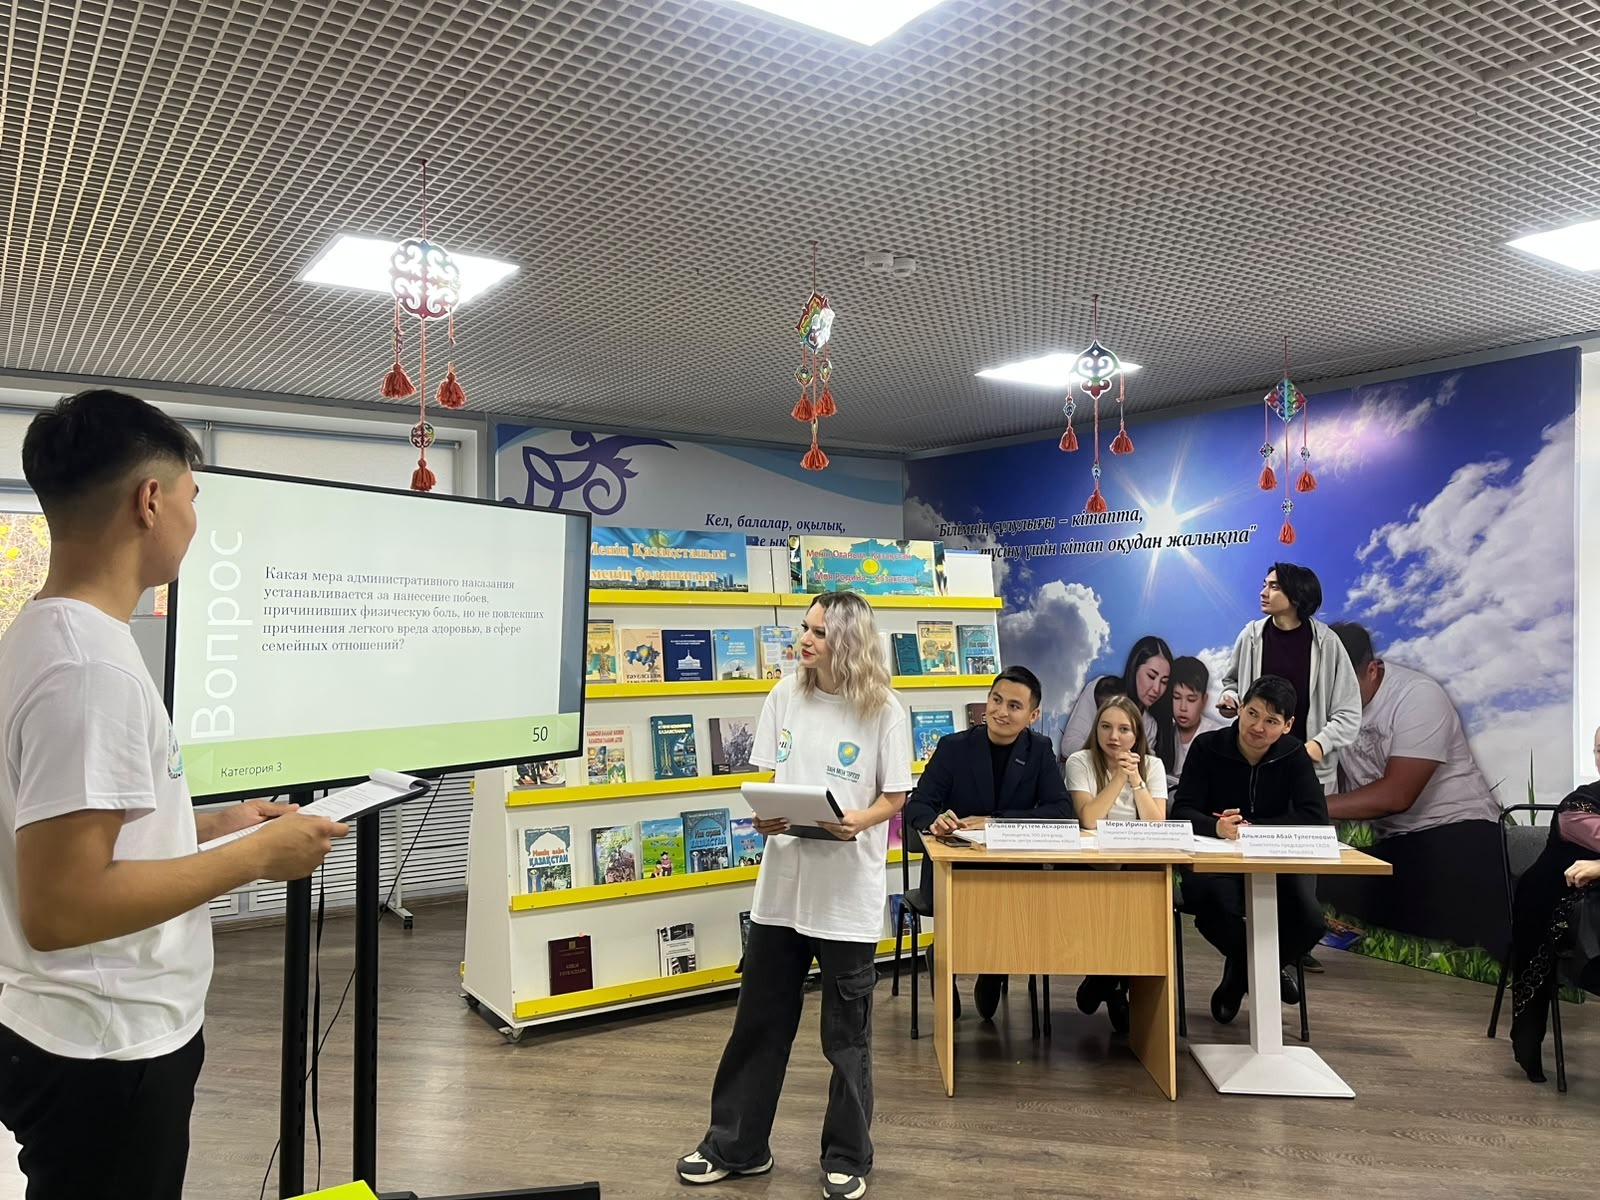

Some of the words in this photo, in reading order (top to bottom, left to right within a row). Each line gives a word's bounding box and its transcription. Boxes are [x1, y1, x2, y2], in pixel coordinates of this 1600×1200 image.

[705, 513, 733, 528] Кел,
[737, 514, 793, 532] балалар,
[796, 519, 847, 534] оқылық,
[935, 520, 989, 537] "Білімнің
[991, 516, 1056, 536] сұлулығы
[1071, 508, 1144, 527] кітапта,
[631, 542, 727, 560] Қазақстаным
[1024, 539, 1057, 560] үшін
[1060, 538, 1105, 555] кітап
[1107, 532, 1163, 554] оқудан
[1166, 525, 1258, 548] жалықпа"
[265, 566, 308, 581] Какая
[312, 571, 343, 585] мера
[346, 573, 460, 588] административного
[461, 579, 515, 590] наказания
[590, 566, 632, 581] менің
[634, 567, 717, 582] болашағым
[263, 587, 374, 600] устанавливается
[376, 590, 390, 601] за
[392, 591, 451, 603] нанесение
[452, 591, 490, 604] побоев,
[263, 606, 357, 619] причинивших
[359, 604, 431, 620] физическую
[432, 606, 461, 619] боль,
[462, 610, 476, 619] но
[477, 610, 490, 619] не
[491, 609, 545, 620] повлекших
[190, 529, 254, 739] Вопрос
[262, 624, 346, 637] причинения
[348, 624, 394, 635] легкого
[396, 624, 429, 637] вреда
[430, 624, 483, 637] здоровью,
[485, 625, 492, 634] в
[492, 622, 522, 636] сфере
[261, 639, 328, 652] семейных
[331, 638, 405, 652] отношений?
[532, 725, 549, 742] 50
[221, 764, 275, 778] Категория
[276, 762, 283, 773] 3
